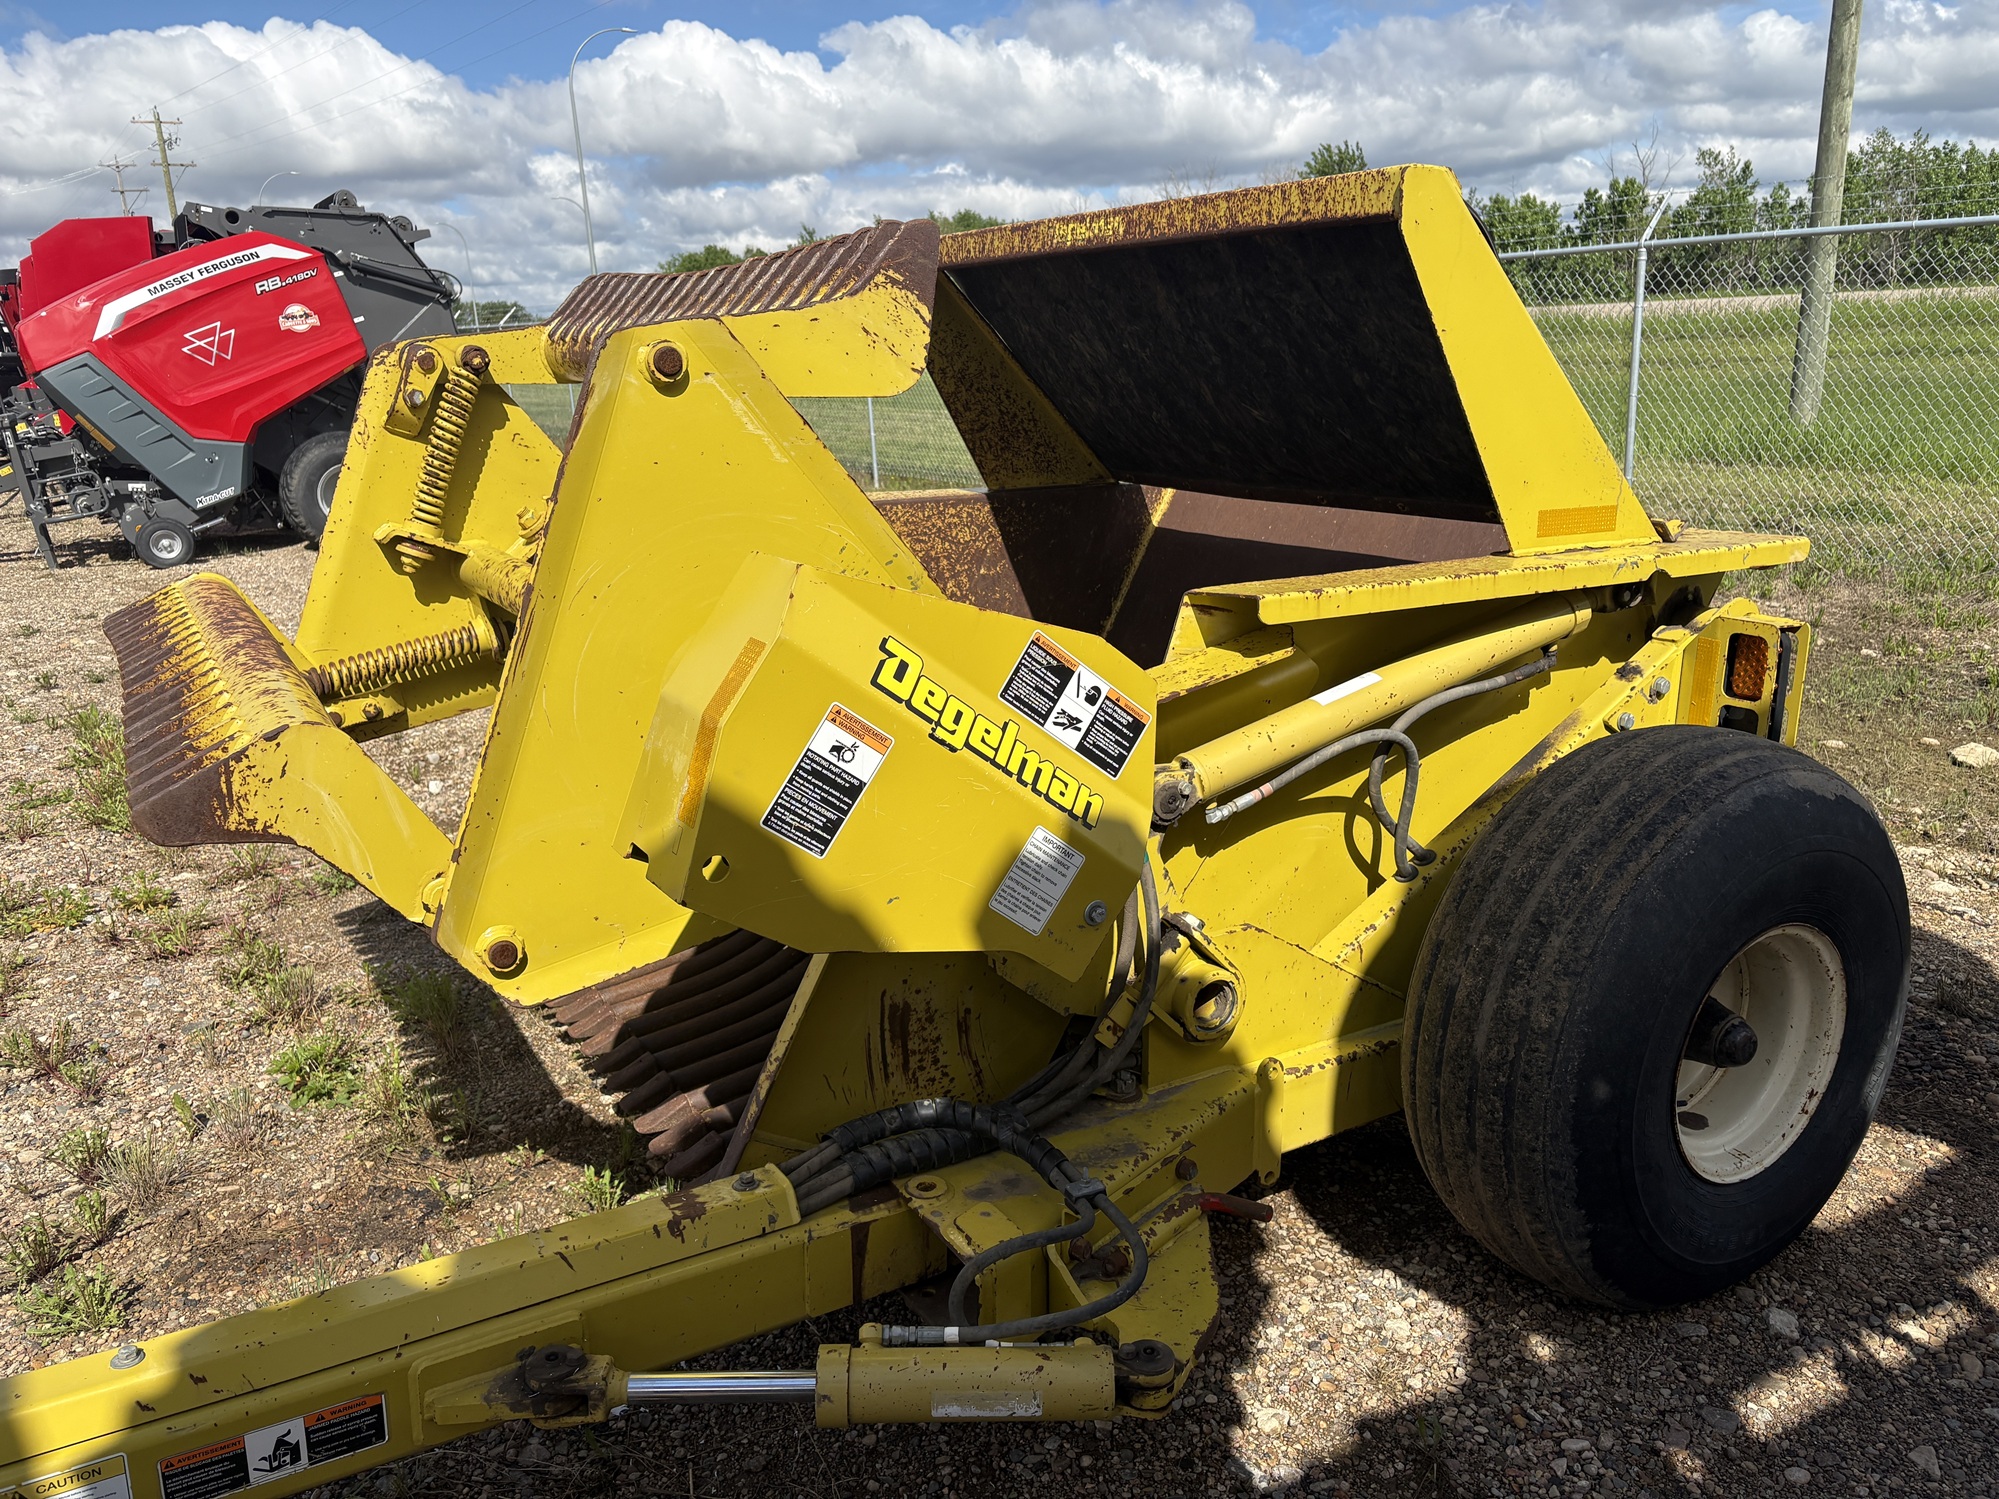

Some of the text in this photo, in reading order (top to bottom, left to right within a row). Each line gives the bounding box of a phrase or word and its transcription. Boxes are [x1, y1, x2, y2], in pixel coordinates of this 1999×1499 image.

[147, 251, 260, 297] MASSEY FERGUSON
[1040, 640, 1077, 669] AVERTISSEMENT
[1123, 703, 1144, 720] WARNING
[837, 719, 866, 740] WARNING
[841, 712, 888, 744] AVERTISSEMENT
[870, 635, 1104, 830] Degelman
[806, 751, 860, 786] ROTATING PART HAZARD
[808, 801, 838, 821] MOUVEMENT
[1029, 841, 1071, 871] CHAIN MAINTENANCE
[1041, 835, 1075, 861] IMPORTANT
[308, 1408, 370, 1431] JAMMED PADDLE HAZARD
[330, 1400, 367, 1416] WARNING
[165, 1467, 182, 1476] RISQUE
[190, 1459, 211, 1468] BLOCAGE
[222, 1448, 244, 1458] PALETTES
[177, 1440, 241, 1464] AVERTISSEMENT
[36, 1467, 102, 1494] CAUTION
